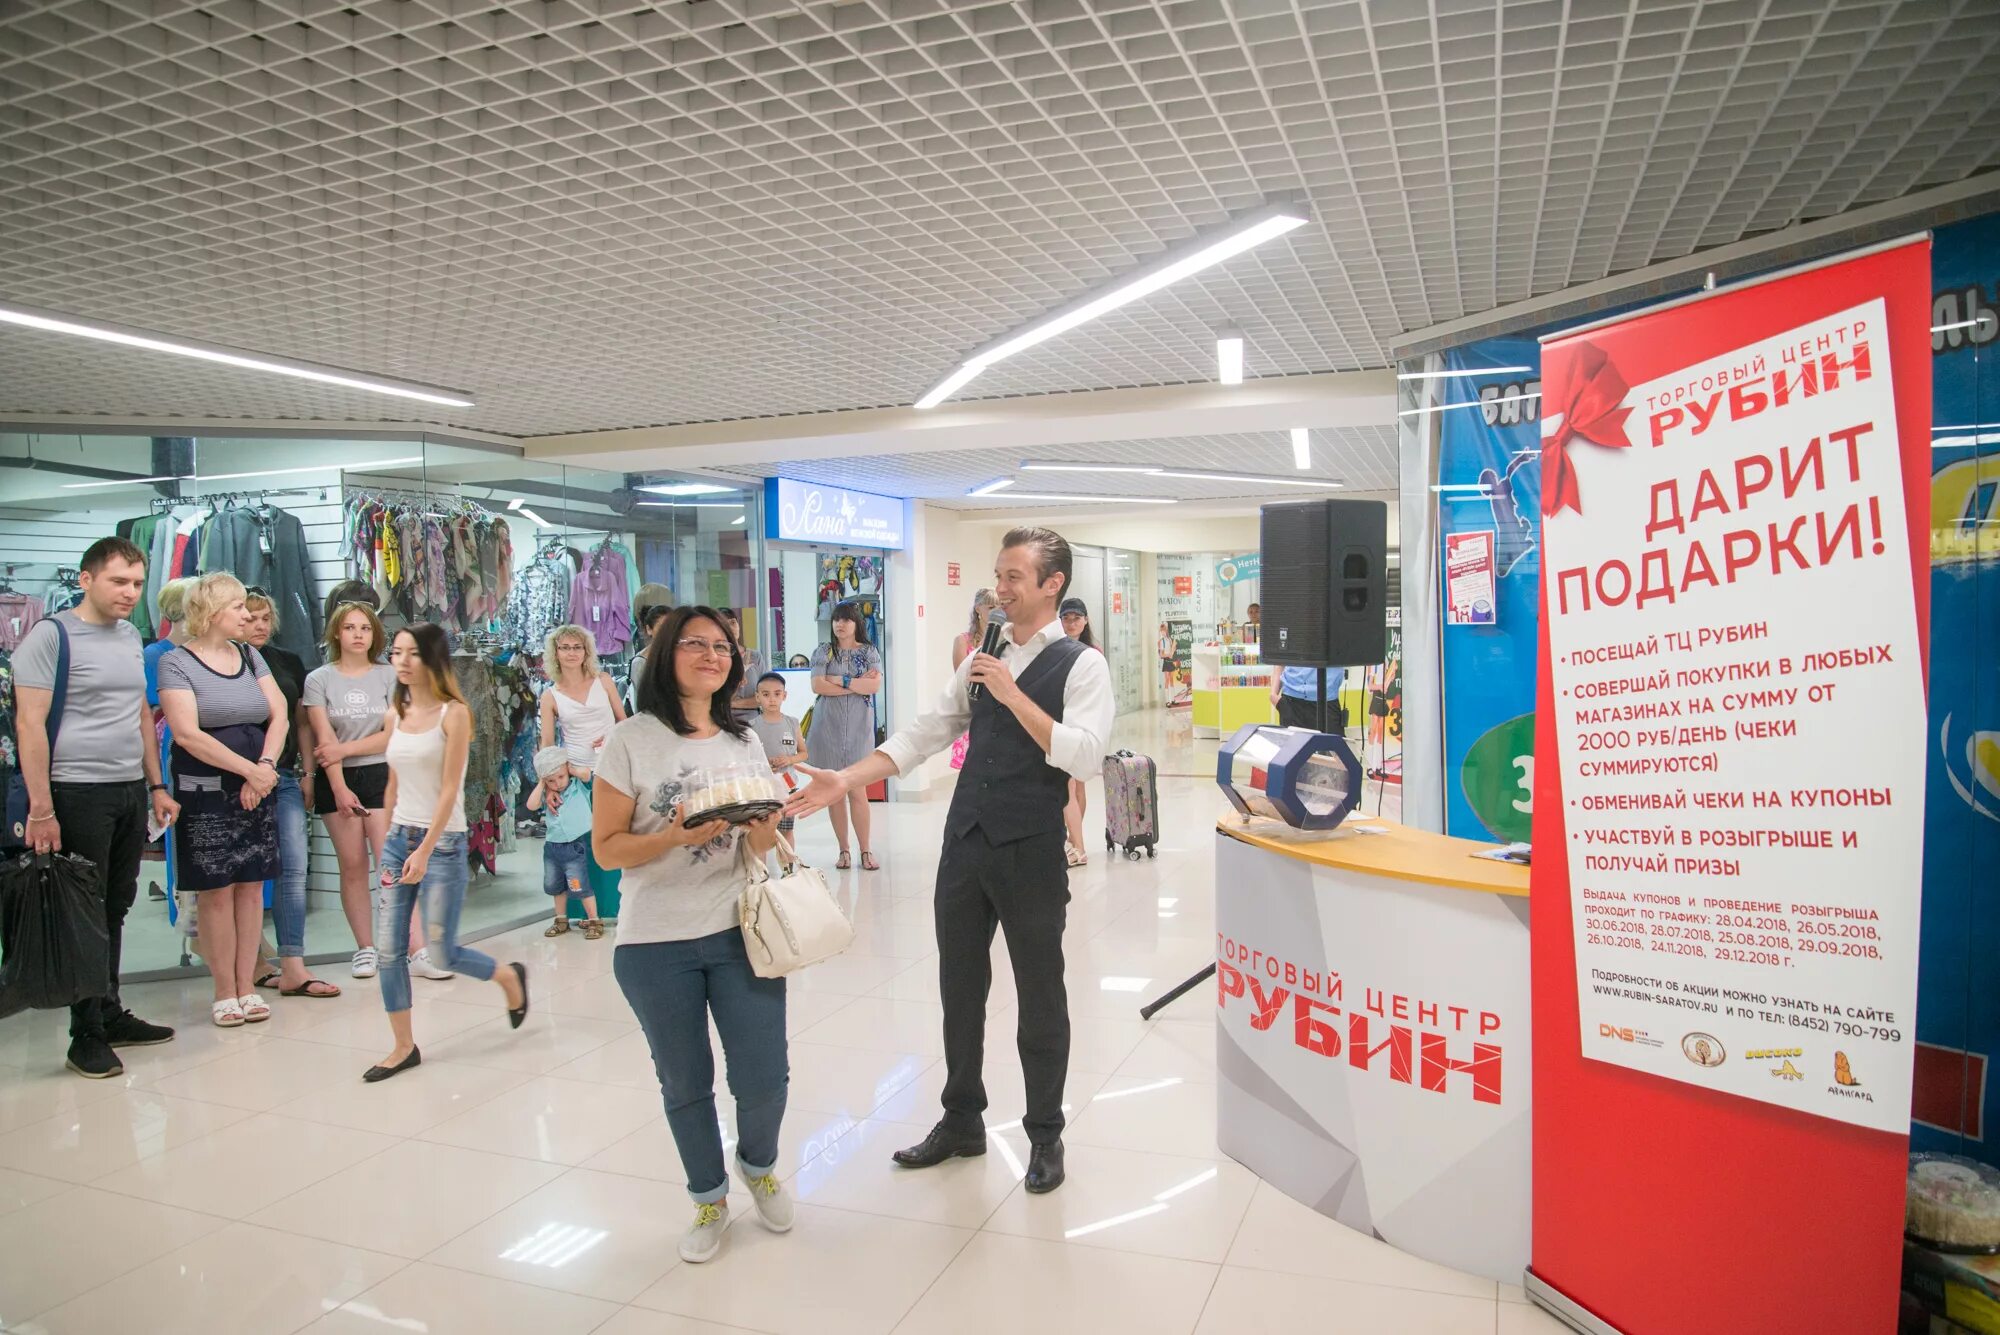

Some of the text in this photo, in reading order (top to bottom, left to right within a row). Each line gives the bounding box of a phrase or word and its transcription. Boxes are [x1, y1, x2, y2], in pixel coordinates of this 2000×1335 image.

[1647, 322, 1866, 410] ТОРГОВЫЙ ЦЕНТР
[1648, 342, 1872, 448] РУБИН
[1645, 422, 1874, 542] ДАРИТ
[1557, 496, 1886, 615] ПОДАРКИ!
[1572, 635, 1658, 666] ПОСЕЩАЙ
[1664, 631, 1692, 652] ТЦ
[1574, 644, 1893, 699] СОВЕРШАЙ ПОКУПКИ В ЛЮБЫХ
[1576, 684, 1835, 725] МАГАЗИНАХ НА СУММУ ОТ
[1578, 720, 1796, 751] 2000 РУБ/ДЕНЬ (ЧЕКИ
[1580, 752, 1718, 776] СУММИРУЮТСЯ)
[1582, 788, 1891, 810] ОБМЕНИВАЙ ЧЕКИ НА КУПОНЫ
[1584, 825, 1857, 848] УЧАСТВУЙ В РОЗЫГРЫШЕ И
[1586, 853, 1740, 876] ПОЛУЧАЙ ПРИЗЫ
[1585, 905, 1881, 941] ПРОХОДИТ ПО ГРАФИКУ: 28.04.2018, 26.05.2018,
[1633, 893, 1681, 905] КУПОНОВ
[1688, 897, 1696, 906] И
[1704, 898, 1782, 913] ПРОВЕДЕНИЕ
[1792, 904, 1879, 920] РОЗЫГРЫША
[1586, 918, 1883, 960] 30.06.2018, 28.07.2018, 25.08.2018, 29.09.2018,
[1587, 933, 1644, 950] 26.10.2018,
[1651, 940, 1706, 958] 24.11.2018,
[1715, 948, 1780, 966] 29.12.2018
[1218, 932, 1501, 1035] ТОРГОВЫЙ ЦЕНТР
[1666, 981, 1679, 991] ОБ
[1683, 984, 1718, 997] АКЦИИ
[1723, 989, 1767, 1004] МОЖНО
[1772, 996, 1819, 1012] УЗНАТЬ
[1824, 1004, 1841, 1016] НА
[1847, 1007, 1894, 1023] САЙТЕ
[1218, 956, 1502, 1105] РУБИН
[1593, 984, 1901, 1042] WWW.RUBIN-SARATOV.RU И ПО ТЕЛ: (8452) 790-799
[1600, 1023, 1634, 1042] DNS
[1828, 1087, 1873, 1103] АВАНГАРД
